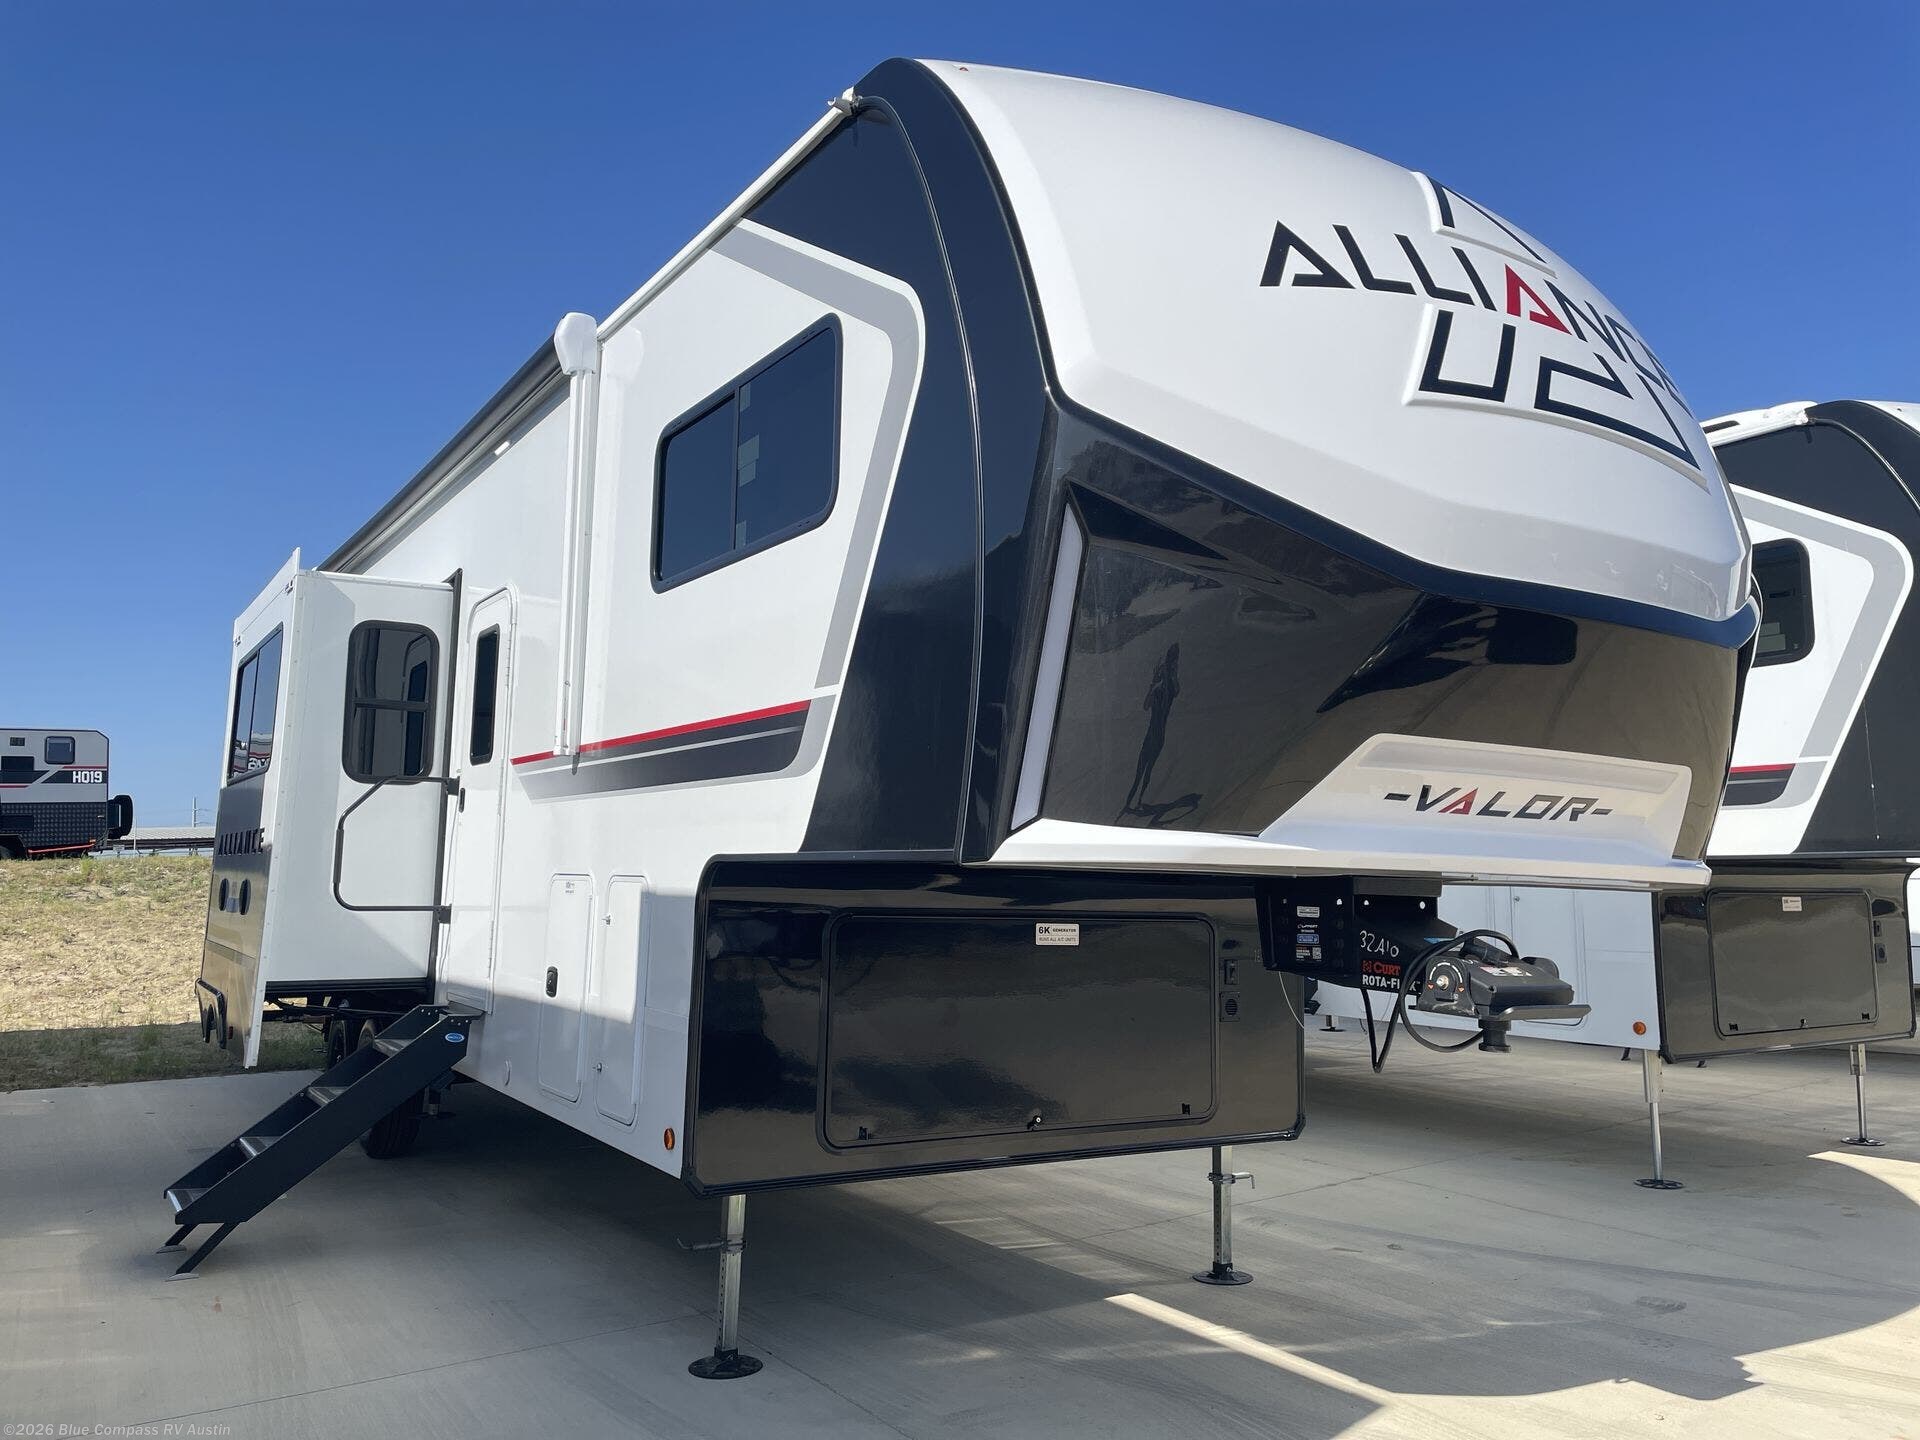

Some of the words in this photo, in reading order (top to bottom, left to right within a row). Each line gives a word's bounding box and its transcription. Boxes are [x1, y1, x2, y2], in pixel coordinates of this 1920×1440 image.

[1259, 219, 1694, 420] ALLIANCE
[217, 826, 265, 856] ALLIANCE
[1038, 926, 1050, 934] 6K
